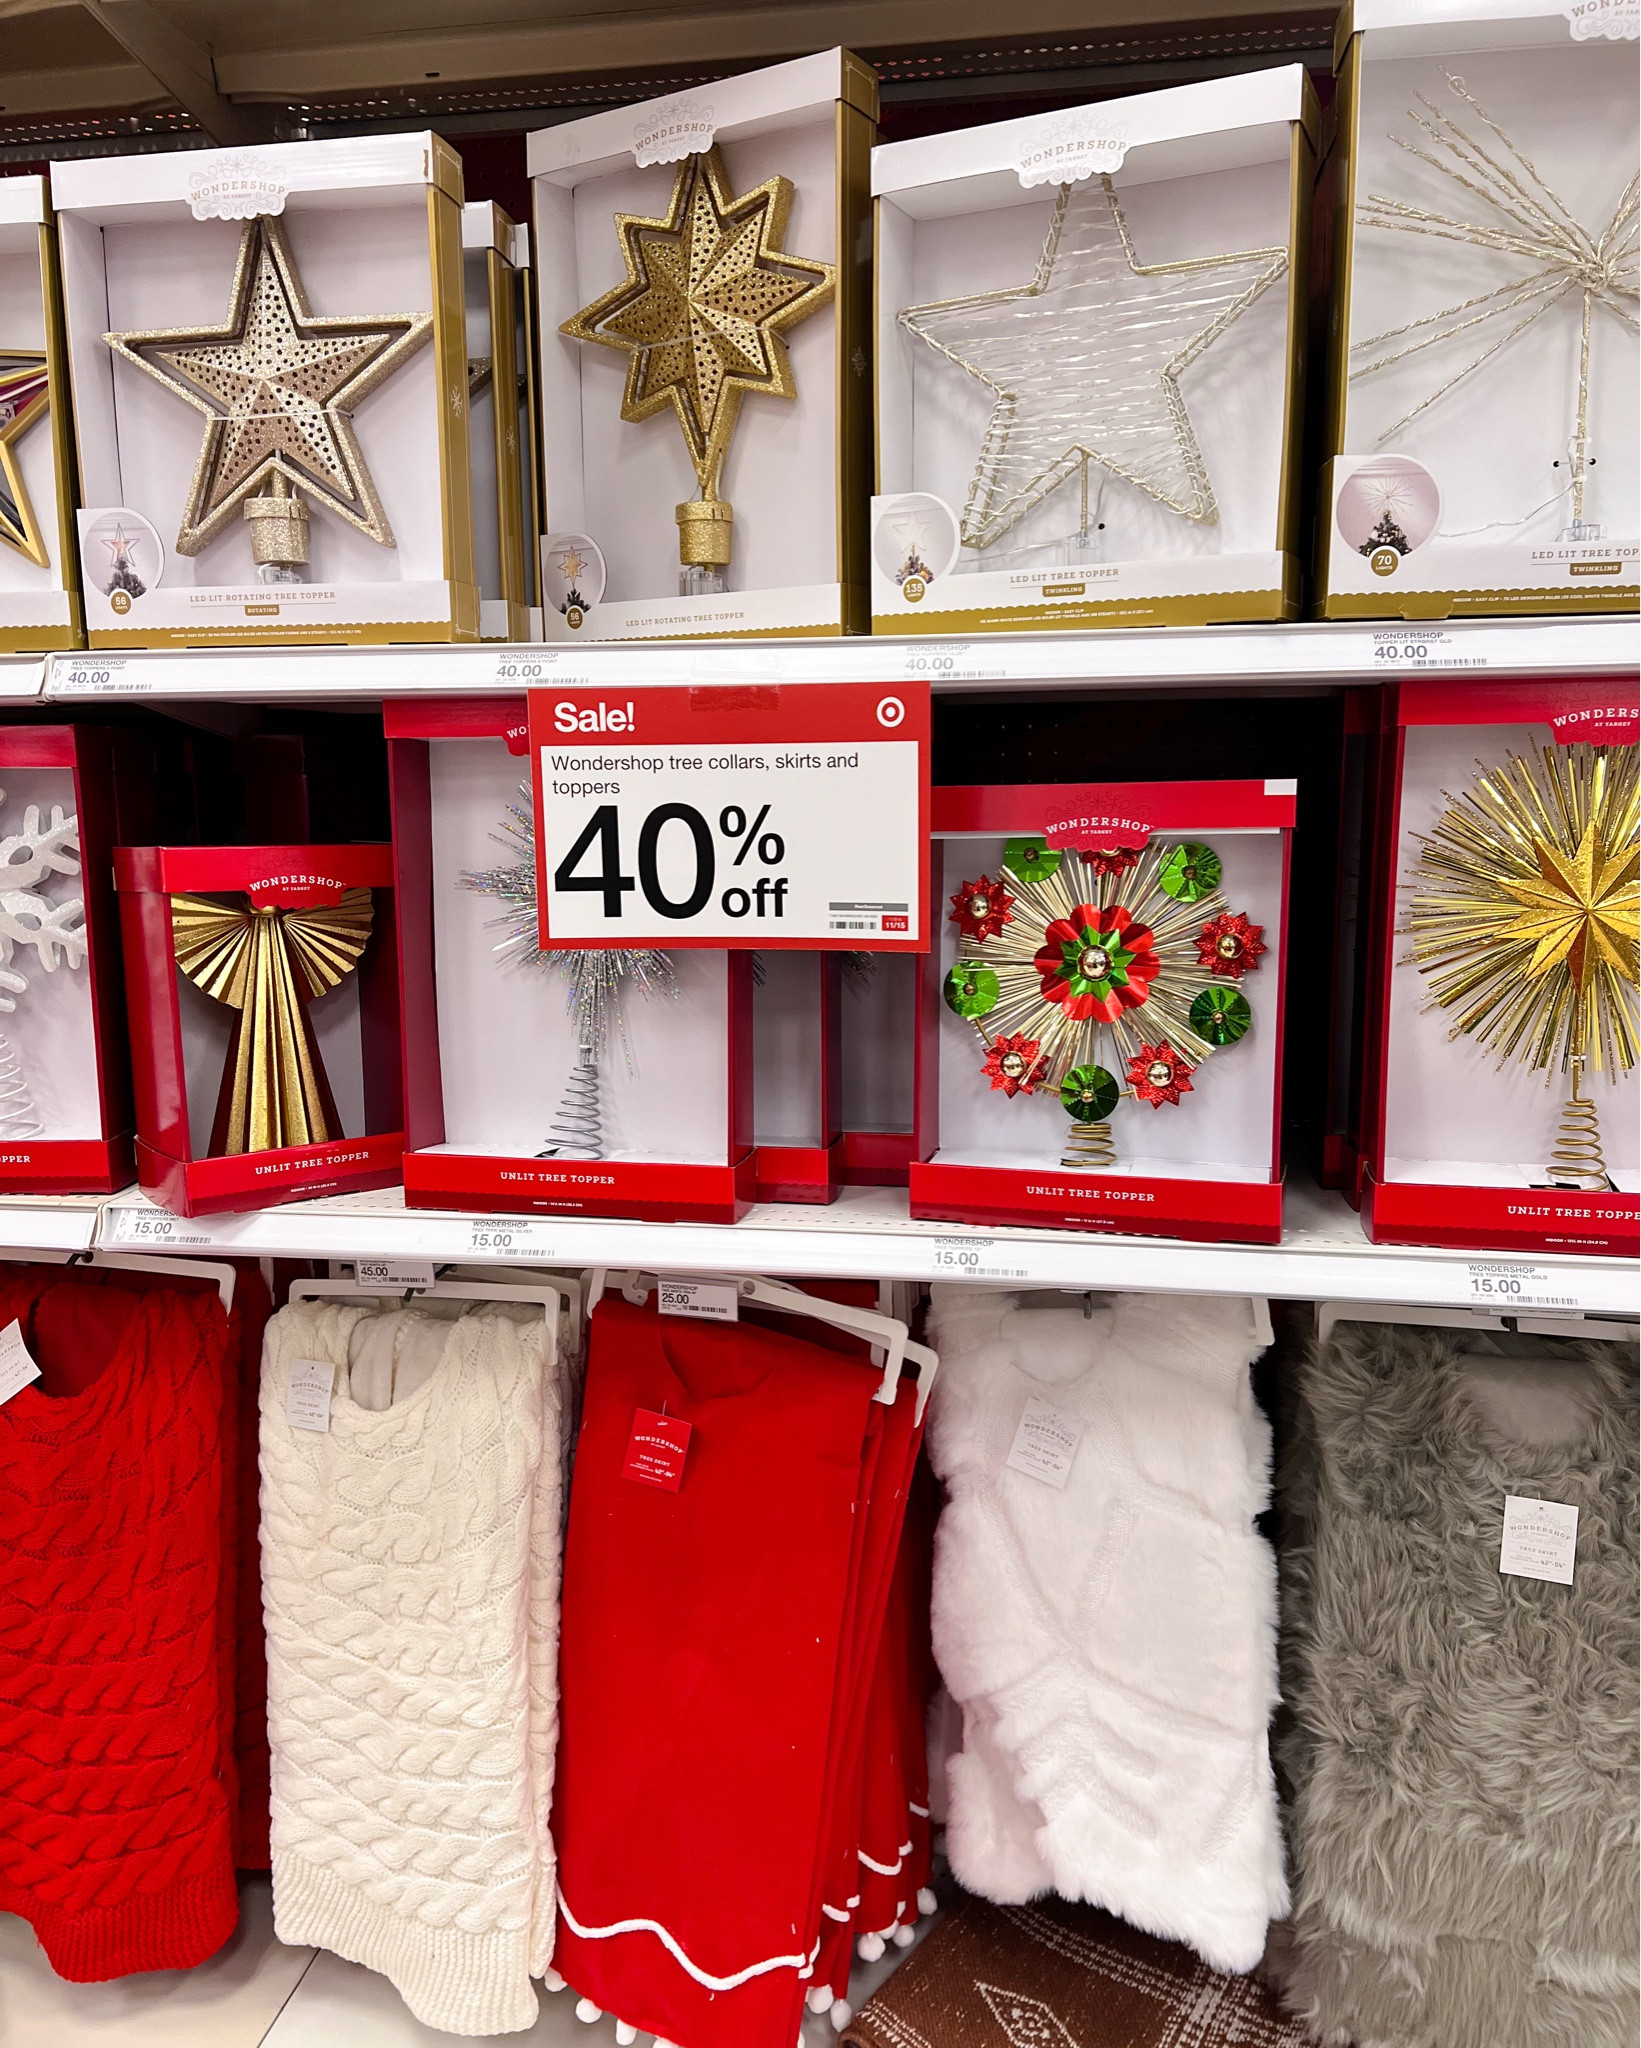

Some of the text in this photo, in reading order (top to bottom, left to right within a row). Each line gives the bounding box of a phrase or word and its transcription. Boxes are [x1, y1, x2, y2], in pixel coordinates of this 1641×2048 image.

[636, 123, 713, 151] WONDERSHOP
[1021, 140, 1126, 168] WONDERSHOP
[191, 180, 285, 201] WONDERSHOP
[1377, 554, 1392, 566] 70
[1532, 552, 1554, 560] LED
[1582, 549, 1611, 558] TREE
[1010, 568, 1119, 584] LED LIT TREE TOPPER
[1573, 565, 1618, 573] TWINKLING
[905, 583, 923, 593] 135
[116, 596, 126, 605] 56
[654, 616, 692, 624] ROTATING
[715, 612, 744, 620] TOPPER
[1374, 645, 1427, 658] 40.00
[497, 665, 542, 677] 40.00
[905, 658, 954, 670] 40.00
[68, 672, 110, 684] 40.00
[554, 701, 635, 733] Sale!
[1553, 708, 1640, 727] WONDERS
[506, 725, 529, 739] WO
[552, 752, 858, 773] Wondershop tree collars, skirts and
[552, 780, 620, 798] toppers
[1046, 817, 1150, 834] WONDERSHOP
[249, 875, 342, 892] WONDERSHOP
[721, 878, 788, 918] off
[255, 1151, 369, 1175] UNLIT TREE TOPPER
[500, 1172, 615, 1184] UNLIT TREE TOPPER
[1026, 1186, 1154, 1202] UNLIT TREE TOPPER
[1507, 1206, 1550, 1216] UNLIT
[1555, 1208, 1591, 1218] TREE
[134, 1222, 172, 1234] 15.00
[472, 1234, 512, 1247] 15.00
[934, 1238, 994, 1247] WONDERSHOP
[935, 1251, 978, 1266] 15.00
[361, 1267, 388, 1276] 45.00
[1468, 1265, 1535, 1274] WONDERSHOP
[1471, 1279, 1521, 1294] 15.00
[662, 1293, 689, 1304] 25.00
[1024, 1423, 1073, 1447] WONDERSHOP
[634, 1436, 684, 1454] WONDERSHOP
[1510, 1525, 1571, 1540] WONDERSHOP
